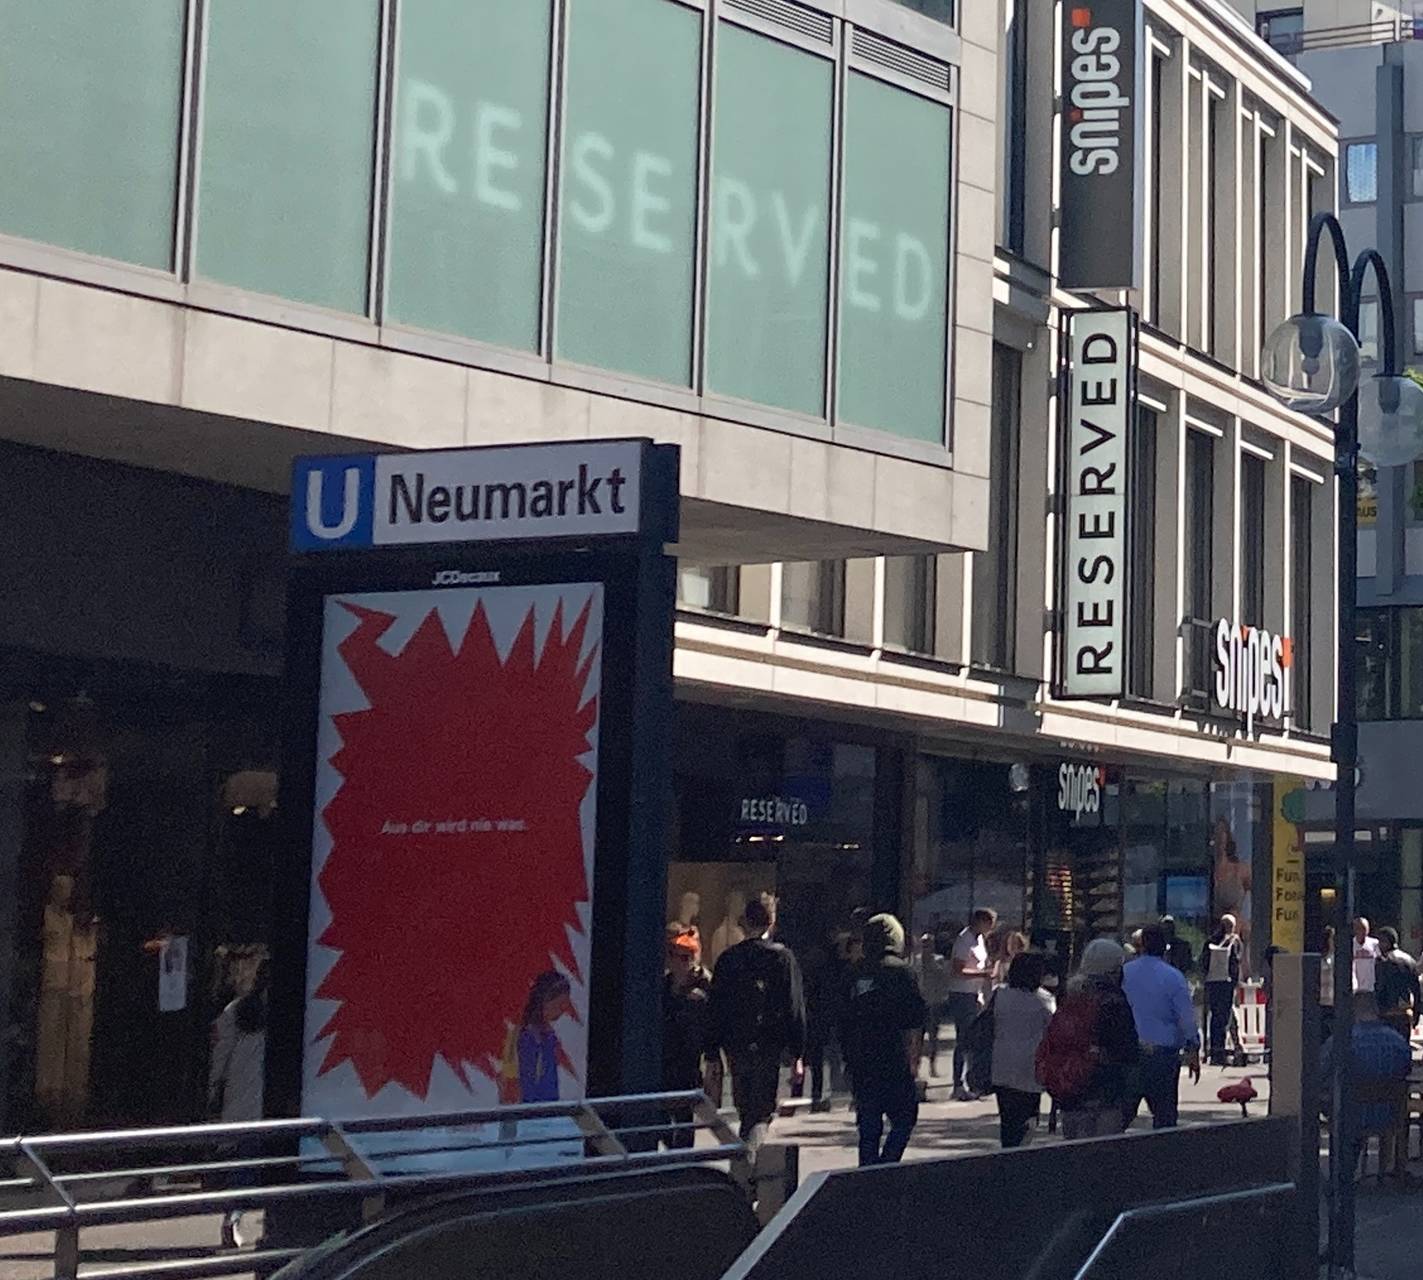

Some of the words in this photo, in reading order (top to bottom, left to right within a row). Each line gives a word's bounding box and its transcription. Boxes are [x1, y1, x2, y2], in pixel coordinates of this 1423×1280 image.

[1070, 27, 1129, 176] snipes
[399, 78, 933, 322] RESERVED
[307, 467, 360, 540] U
[388, 464, 626, 525] Neumarkt
[1076, 332, 1118, 676] RESERVED
[1216, 617, 1284, 732] snipes
[382, 820, 408, 834] Aus
[411, 819, 432, 833] dir
[435, 819, 467, 833] wird
[470, 818, 492, 832] nie
[741, 799, 808, 825] RESERVED
[1058, 762, 1101, 820] snipes
